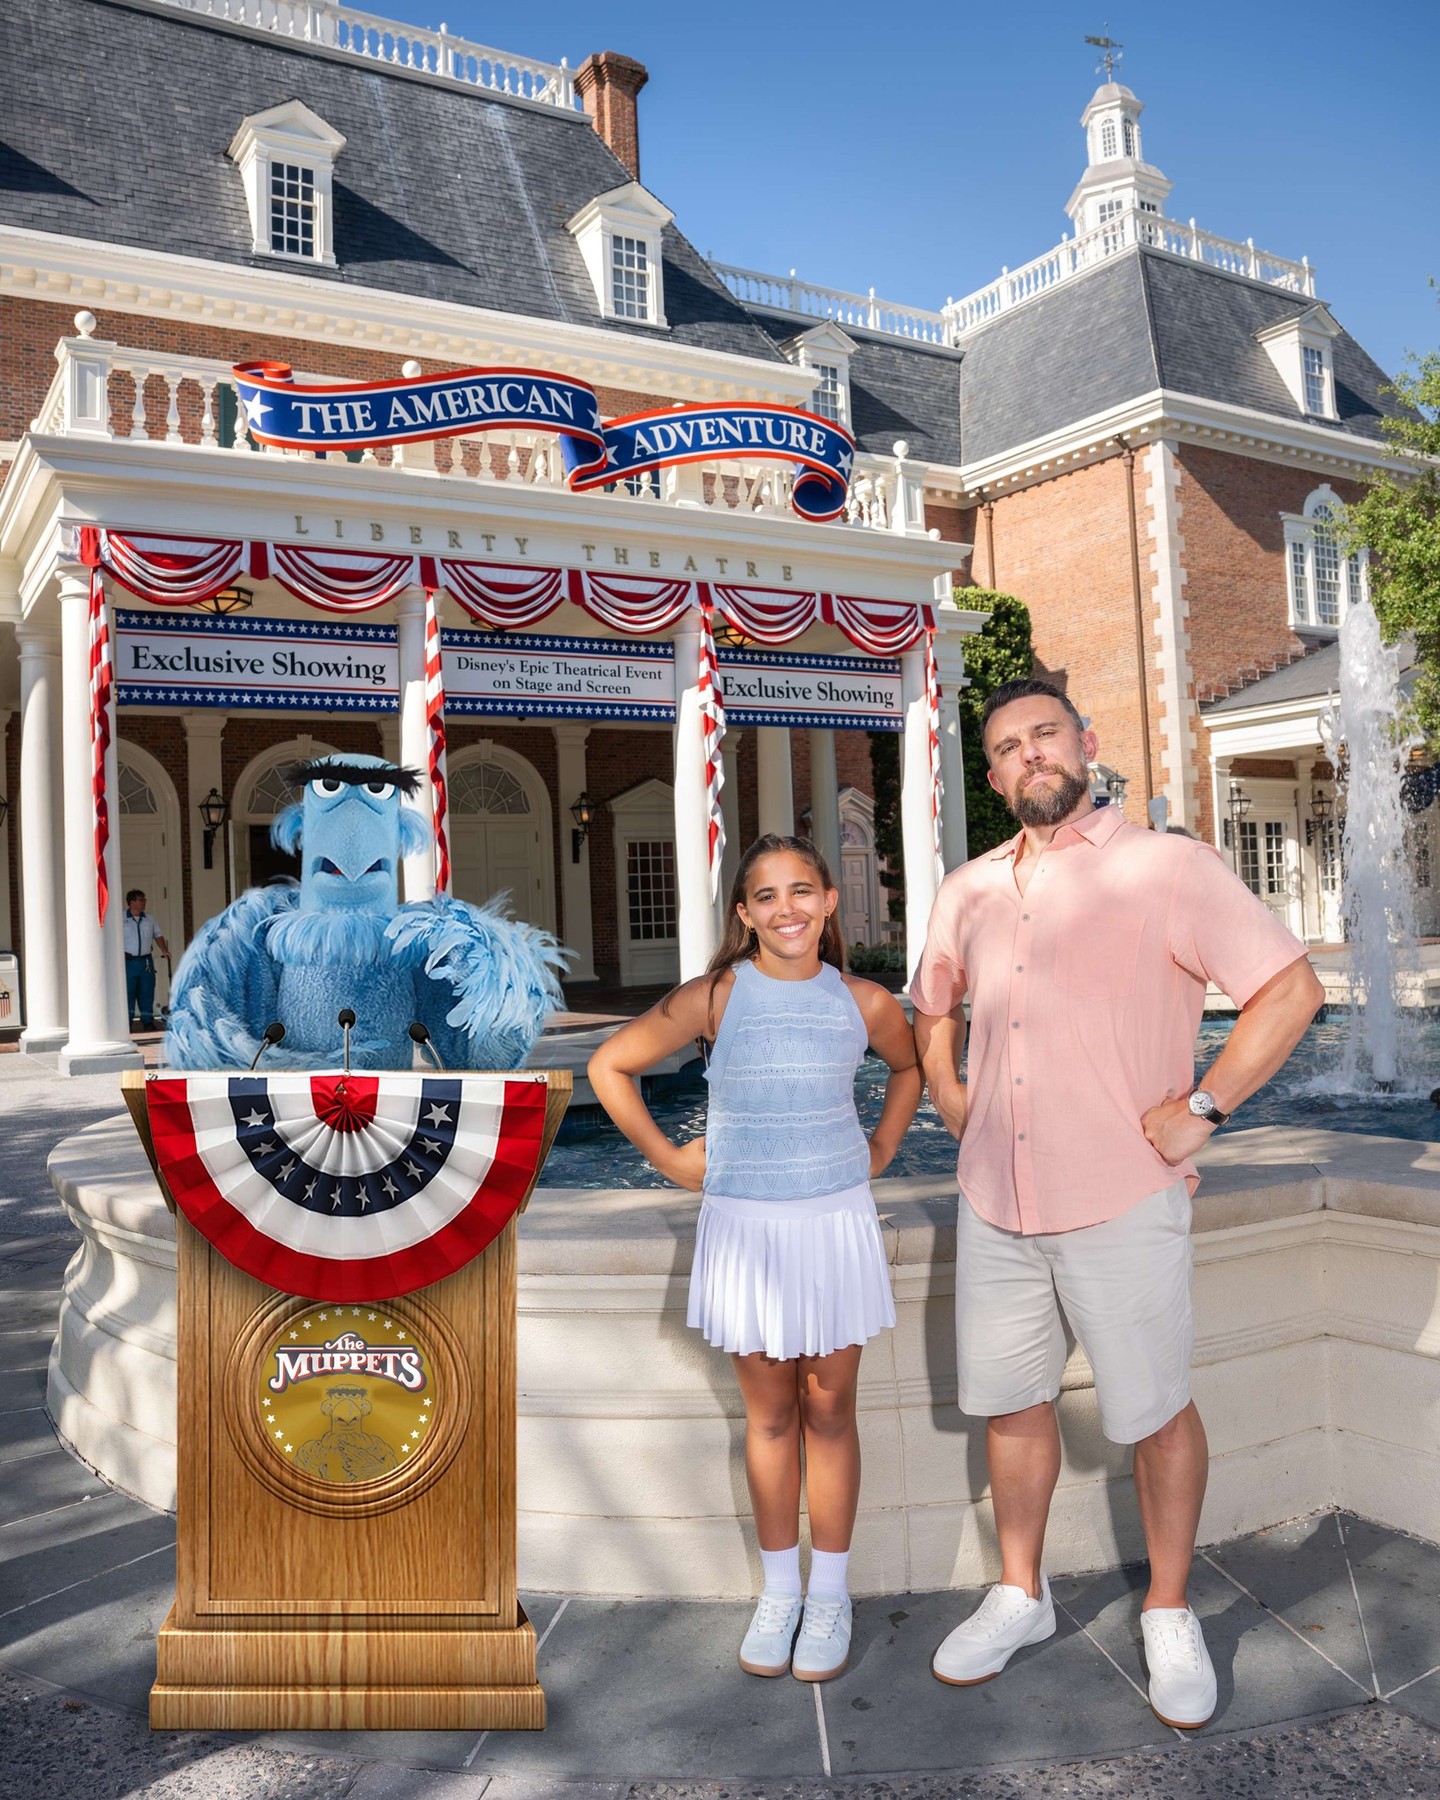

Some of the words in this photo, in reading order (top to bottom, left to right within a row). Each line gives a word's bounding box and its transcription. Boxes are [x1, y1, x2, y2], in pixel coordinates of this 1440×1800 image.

[290, 393, 377, 435] THE
[386, 384, 575, 430] AMERICAN
[630, 416, 828, 459] ADVENTURE
[294, 515, 528, 555] LIBERTY
[582, 543, 793, 581] THEATRE
[130, 645, 265, 675] Exclusive
[272, 651, 387, 685] Showing
[456, 656, 516, 676] Disney's
[519, 659, 550, 676] Epic
[552, 660, 622, 679] Theatrical
[625, 665, 663, 681] Event
[492, 678, 512, 690] on
[515, 679, 553, 695] Stage
[556, 678, 582, 694] and
[585, 680, 632, 696] Screen
[722, 675, 812, 702] Exclusive
[816, 681, 895, 708] Showing
[324, 1333, 366, 1351] The
[269, 1352, 425, 1390] MUPPETS
